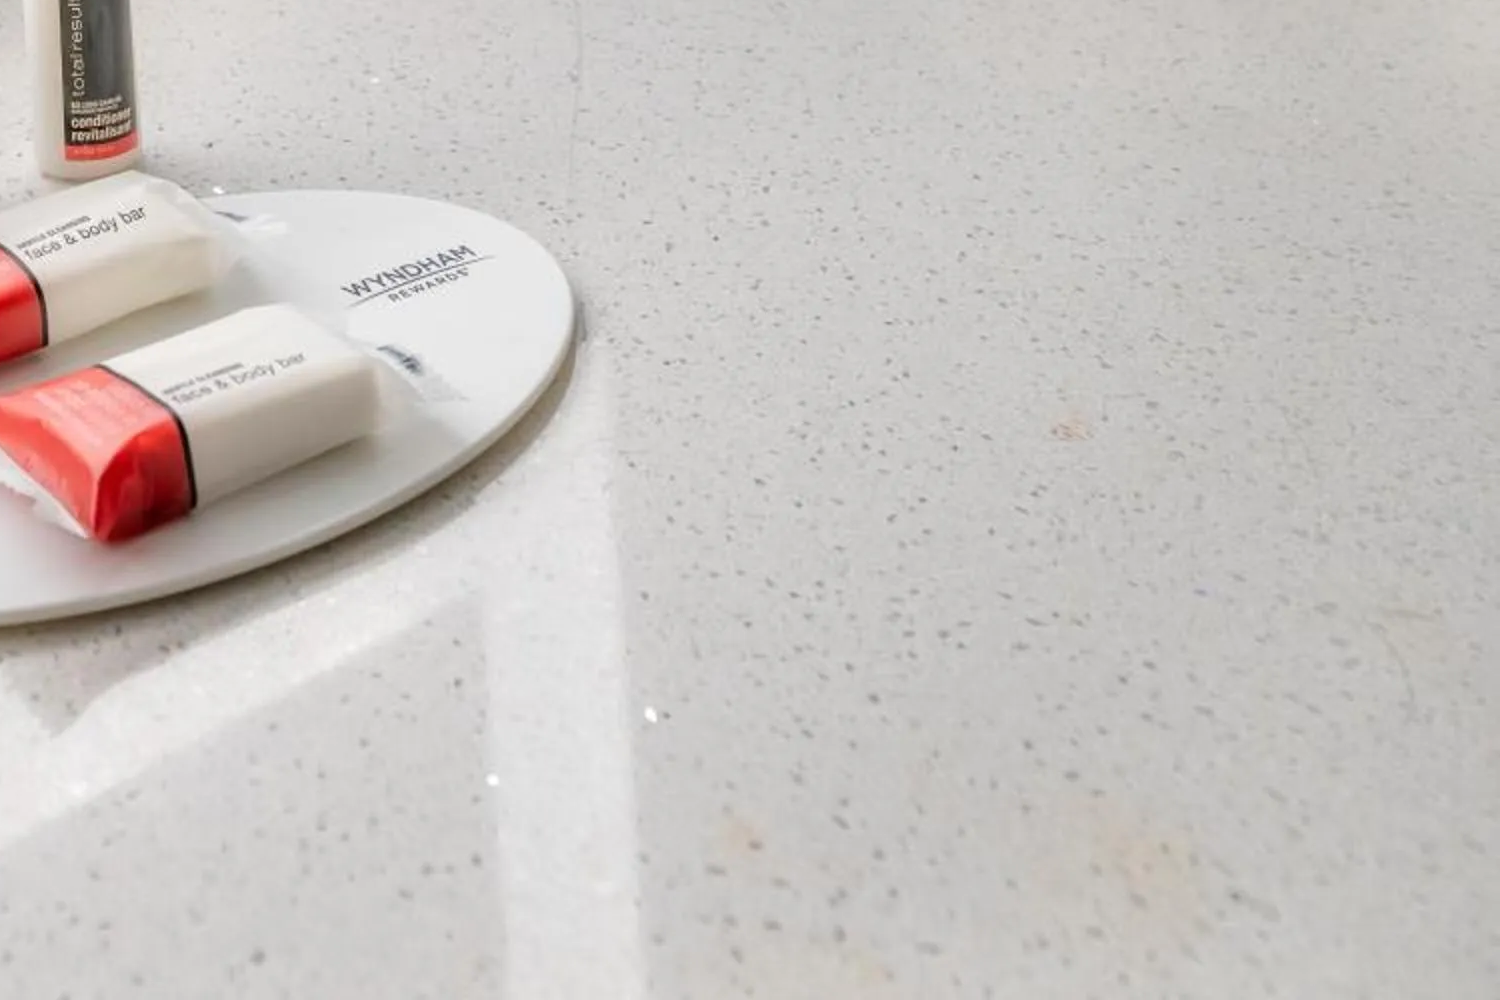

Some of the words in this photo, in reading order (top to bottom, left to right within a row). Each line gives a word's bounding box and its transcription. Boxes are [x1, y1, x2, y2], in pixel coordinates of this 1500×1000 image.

[23, 241, 62, 261] face
[63, 233, 78, 245] &
[76, 218, 119, 240] body
[117, 206, 147, 225] bar
[340, 245, 478, 298] WYNDHAM
[171, 385, 213, 406] face
[214, 379, 228, 390] &
[229, 364, 276, 386] body
[274, 352, 306, 369] bar
